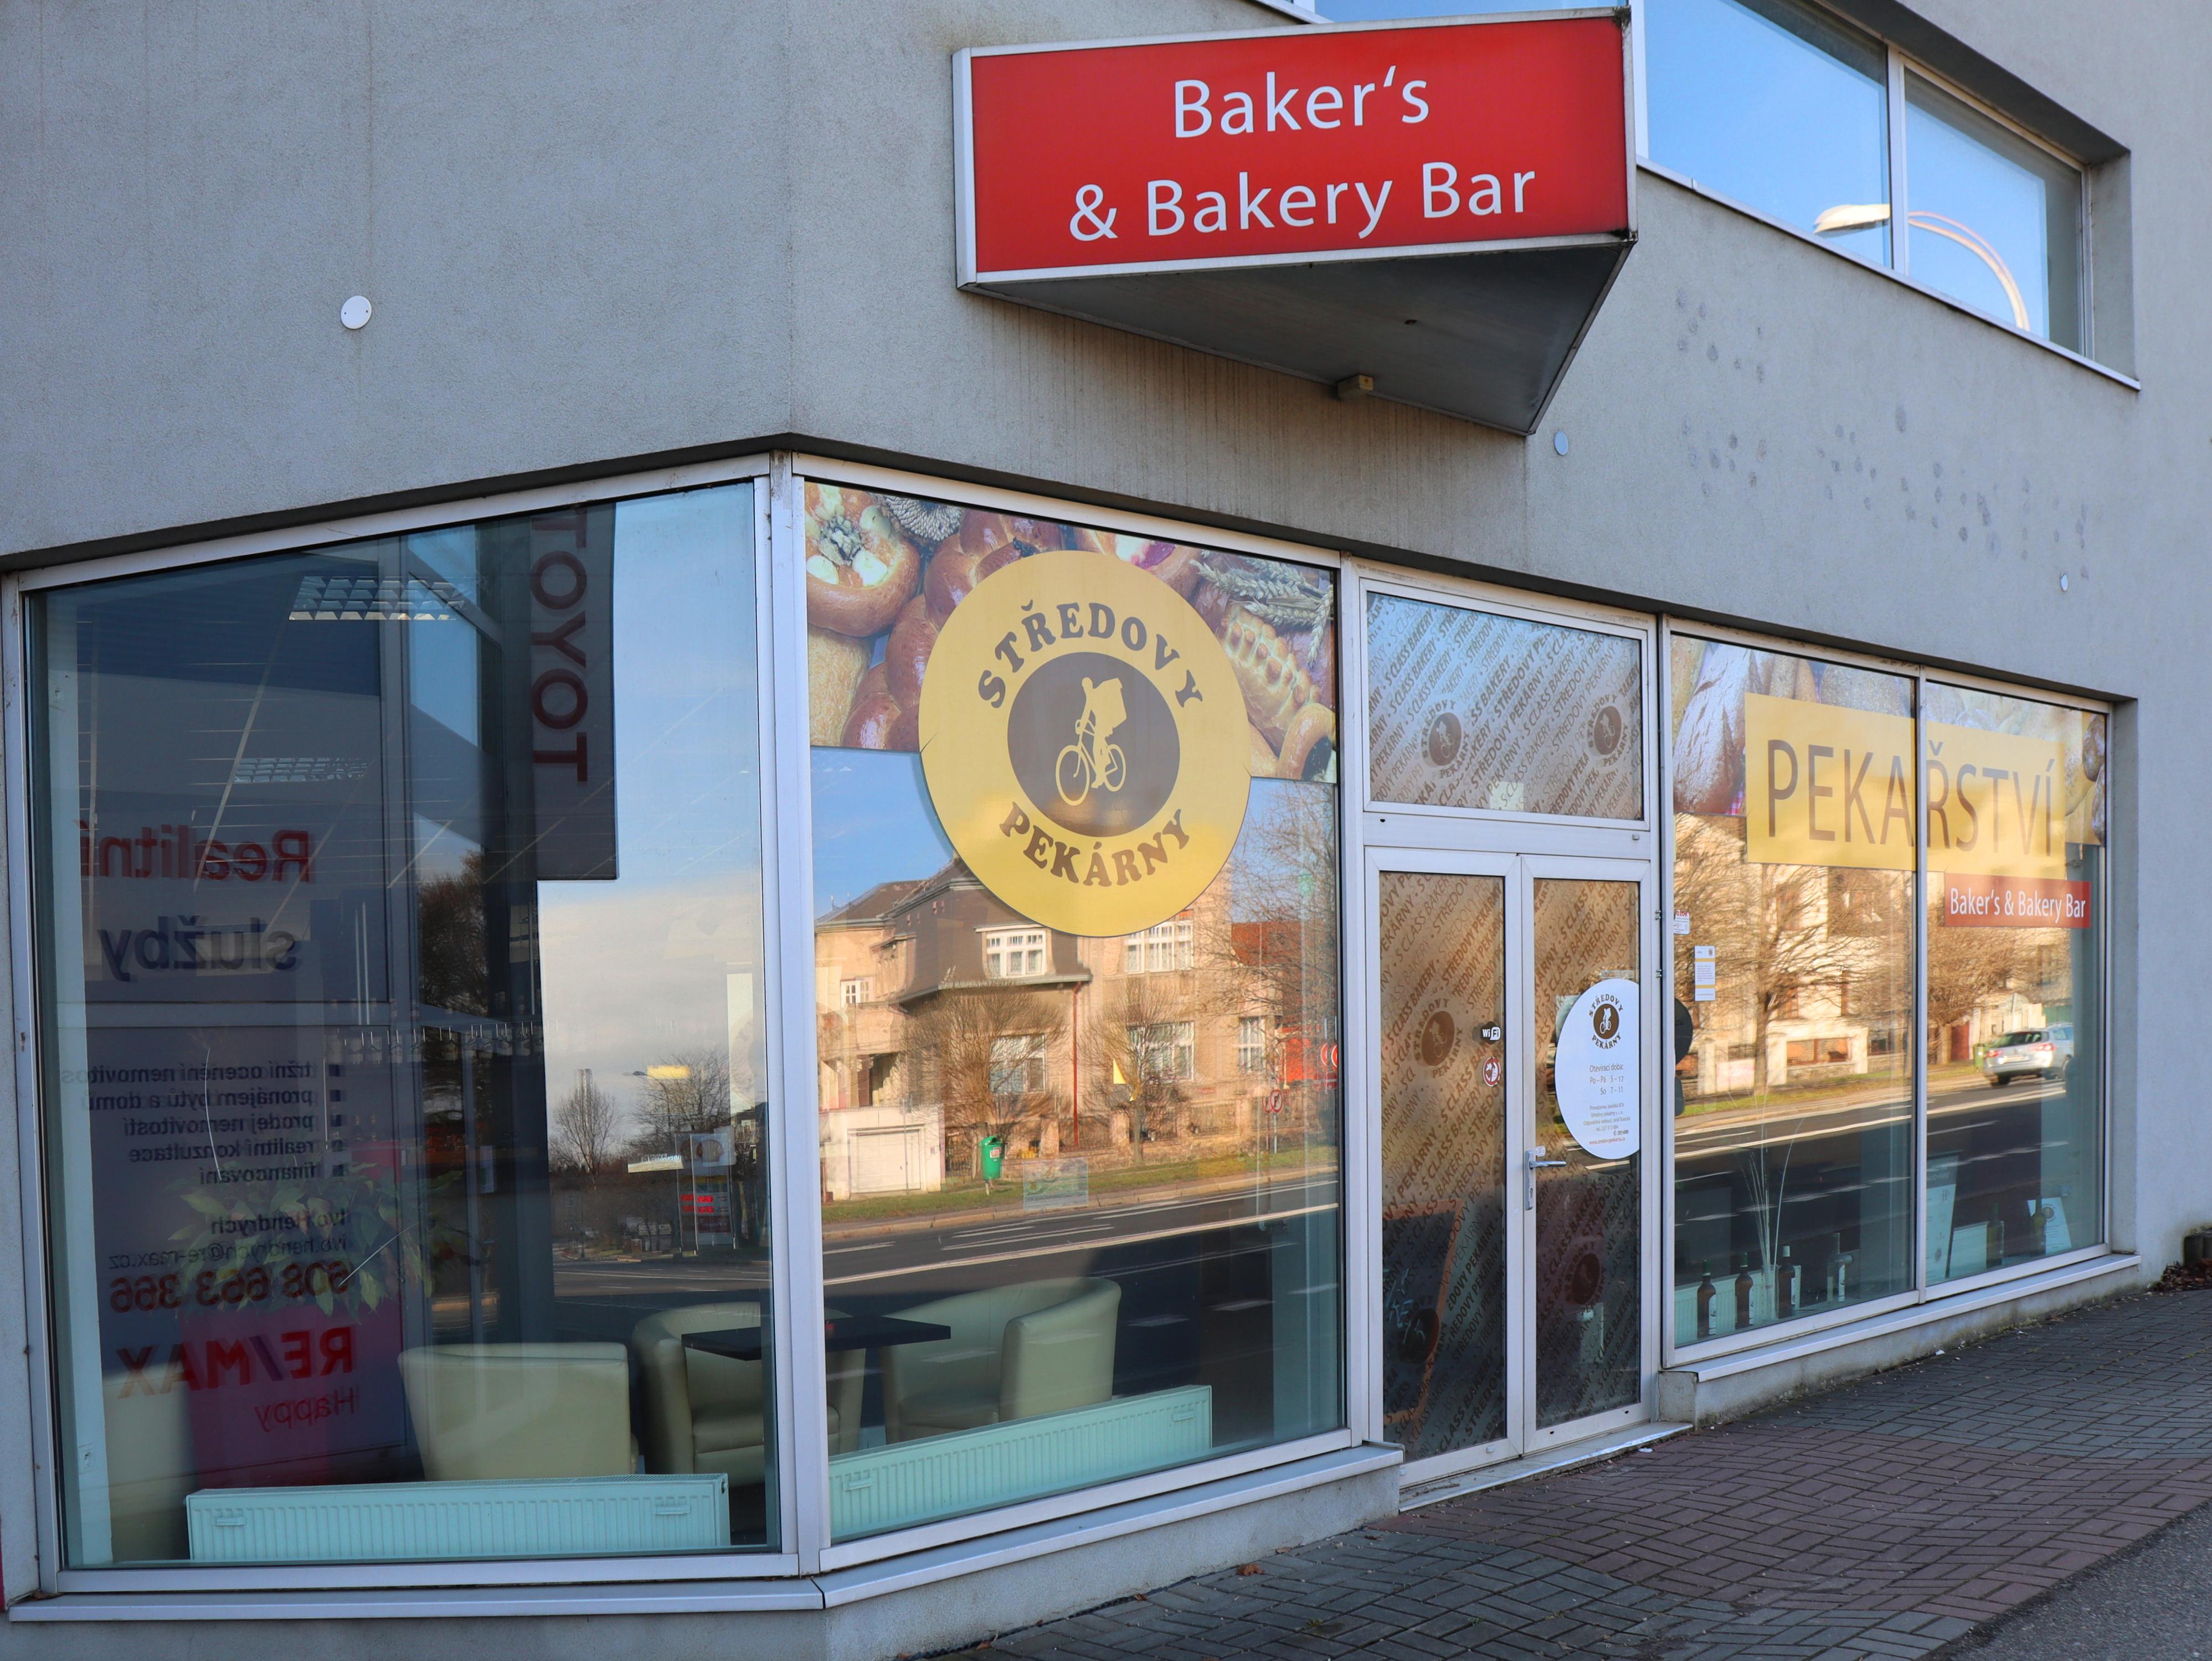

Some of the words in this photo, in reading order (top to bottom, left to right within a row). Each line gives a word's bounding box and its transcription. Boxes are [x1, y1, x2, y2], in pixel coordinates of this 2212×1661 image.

[1069, 183, 1118, 242] &
[1145, 171, 1393, 239] Bakery
[1421, 161, 1536, 220] Bar
[978, 599, 1203, 709] STŘEDOVY
[1390, 644, 1410, 679] CLASS
[1408, 607, 1434, 652] BAKERY
[1395, 672, 1414, 706] CLASS
[1412, 637, 1437, 680] BAKERY
[1412, 681, 1431, 715] CLASS
[1428, 647, 1452, 689] BAKERY
[1480, 654, 1511, 708] BAKERY
[1529, 688, 1551, 726] CLASS
[1549, 645, 1575, 693] BAKERY
[1506, 760, 1528, 798] CLASS
[1525, 718, 1551, 765] BAKERY
[1767, 739, 2055, 858] PEKAŘSTVÍ
[1000, 802, 1190, 887] PEKÁRNY
[1401, 910, 1426, 952] CLASS
[1566, 889, 1589, 930] CLASS
[2004, 890, 2014, 916] &
[2018, 890, 2062, 924] Bakery
[2066, 893, 2086, 918] Bar
[1549, 951, 1571, 992] CLASS
[1570, 904, 1596, 955] BAKERY
[1411, 960, 1437, 1007] BAKERY
[1589, 993, 1623, 1017] STŘEDOVY
[1592, 1031, 1622, 1049] PEKÁRNY
[1427, 1133, 1453, 1179] CLASS
[1451, 1085, 1480, 1138] BAKERY
